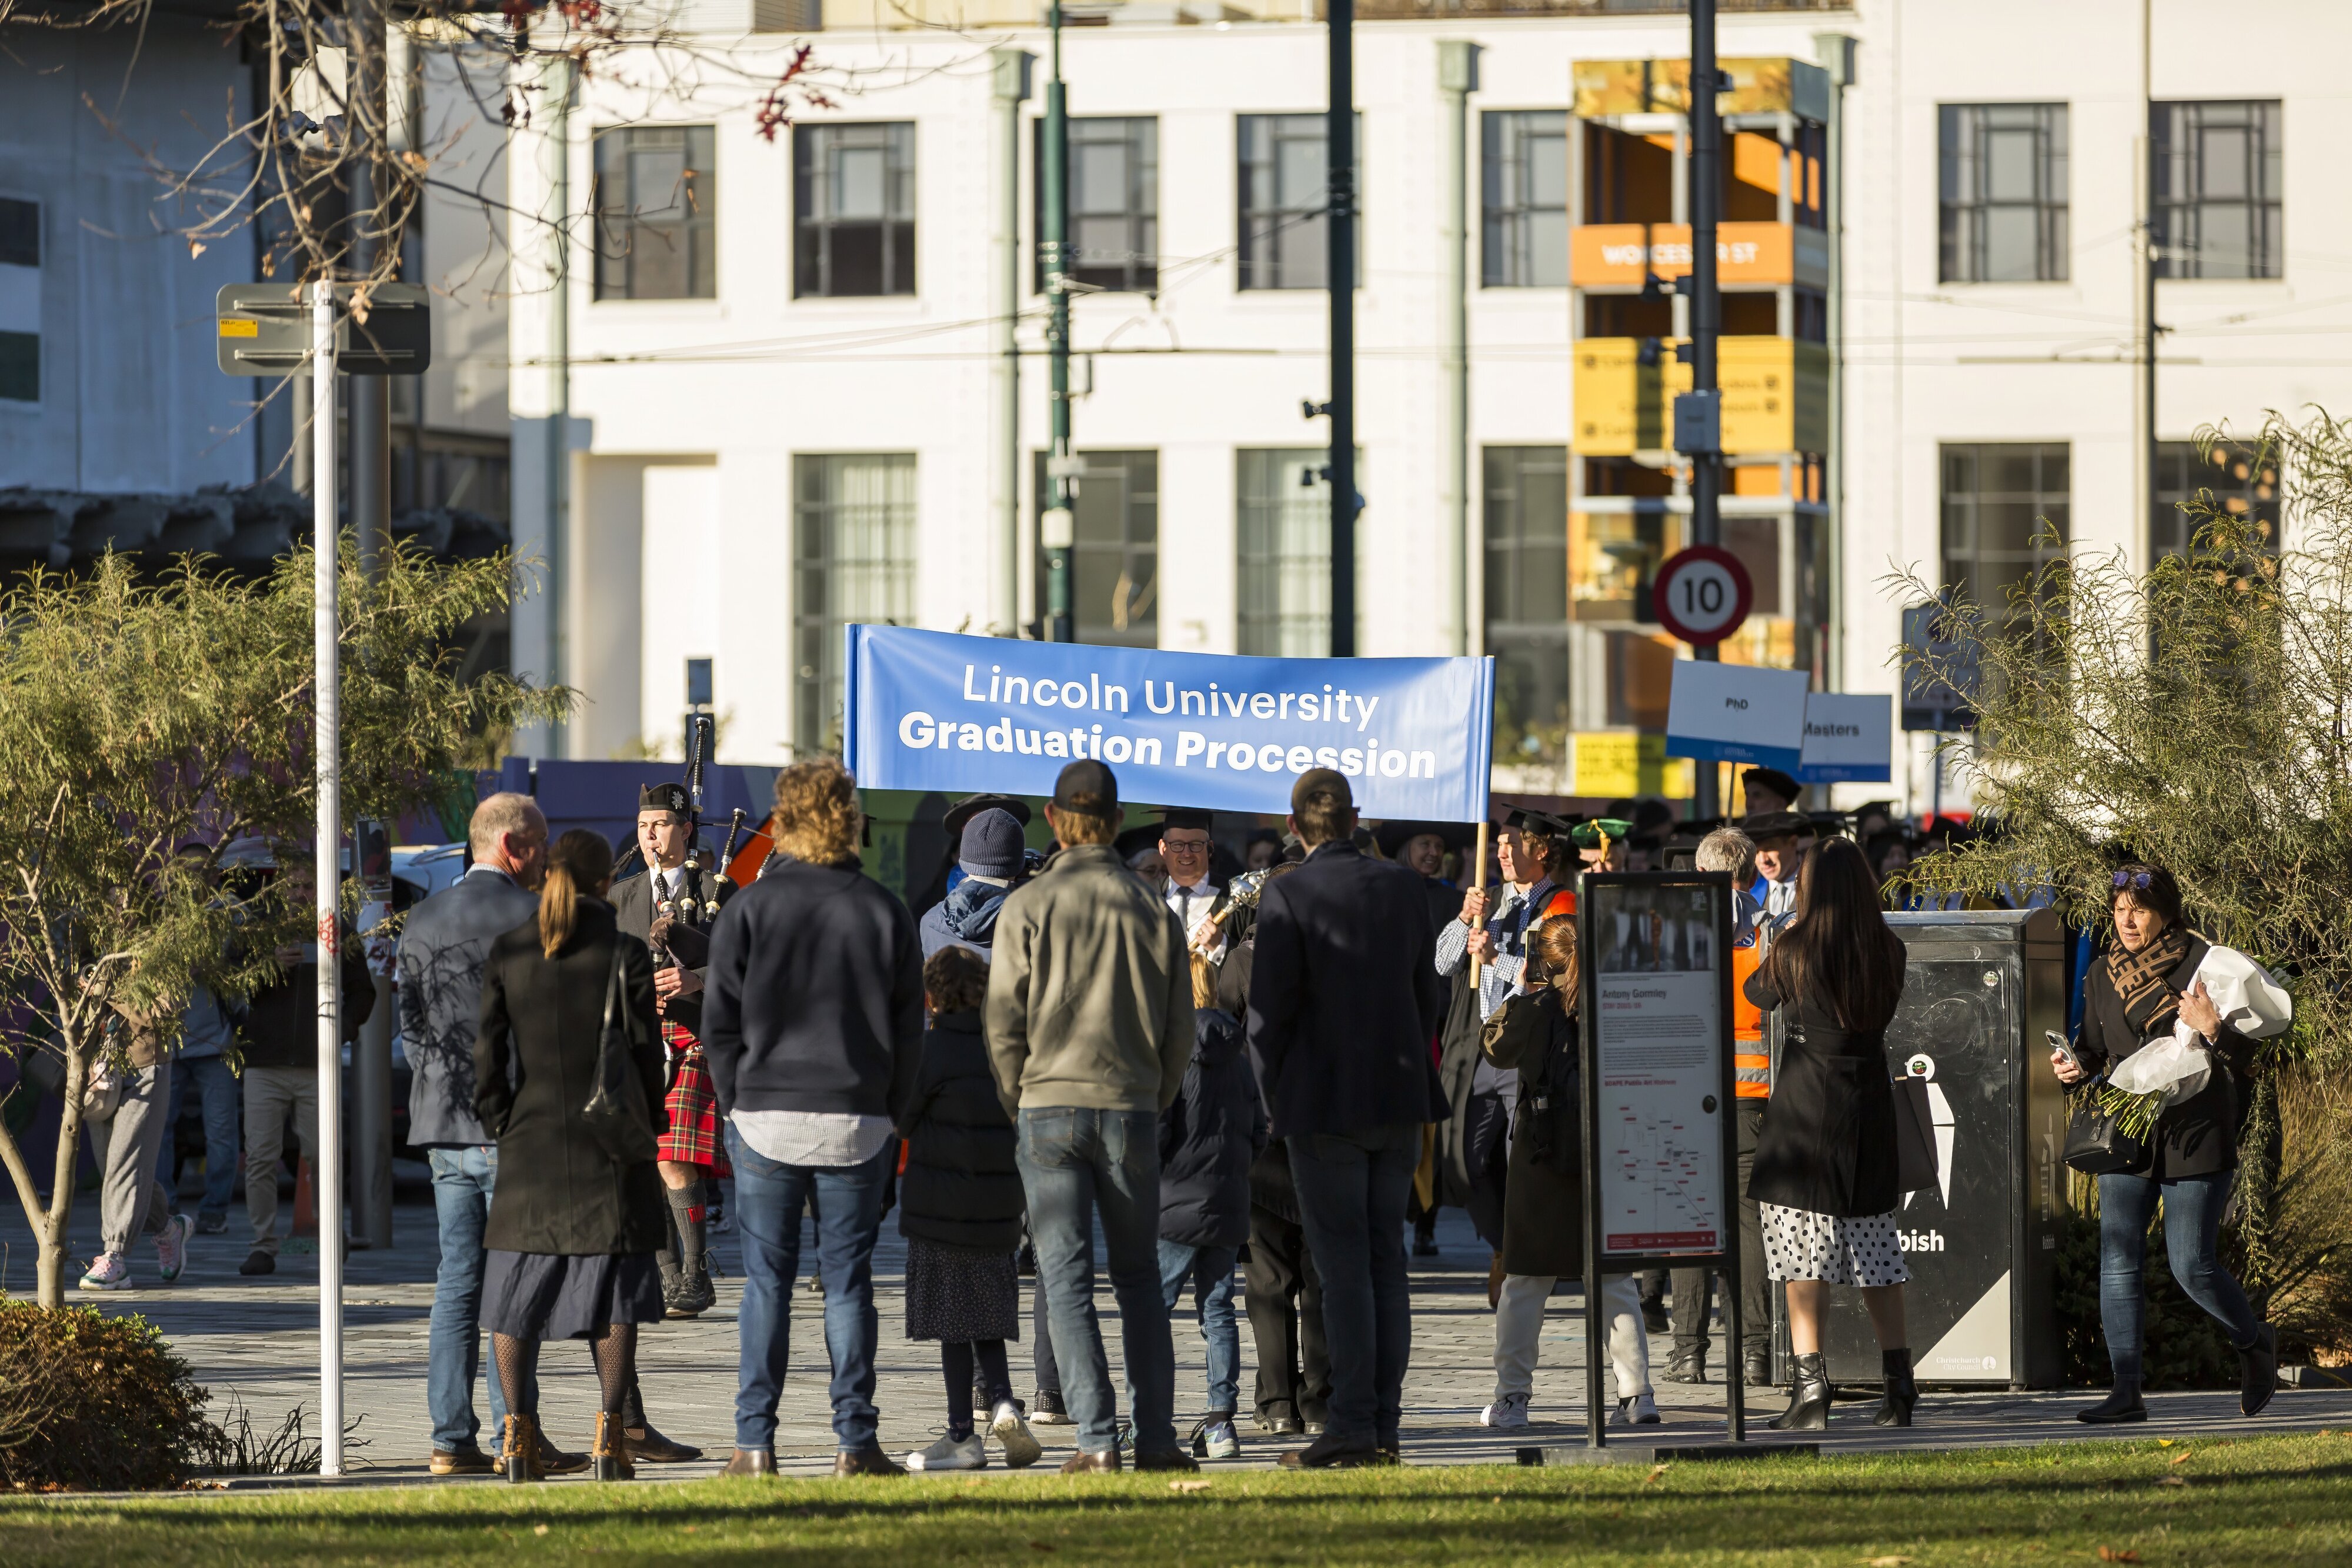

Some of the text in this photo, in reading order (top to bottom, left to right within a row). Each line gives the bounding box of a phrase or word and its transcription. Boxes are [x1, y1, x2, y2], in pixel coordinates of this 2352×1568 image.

[1601, 241, 1760, 266] WOCESR ST
[1684, 577, 1724, 613] 10
[963, 663, 1380, 732] Lincoln University
[1726, 697, 1749, 710] PhD
[898, 711, 1436, 779] Graduation Procession
[1896, 1229, 1944, 1252] bish
